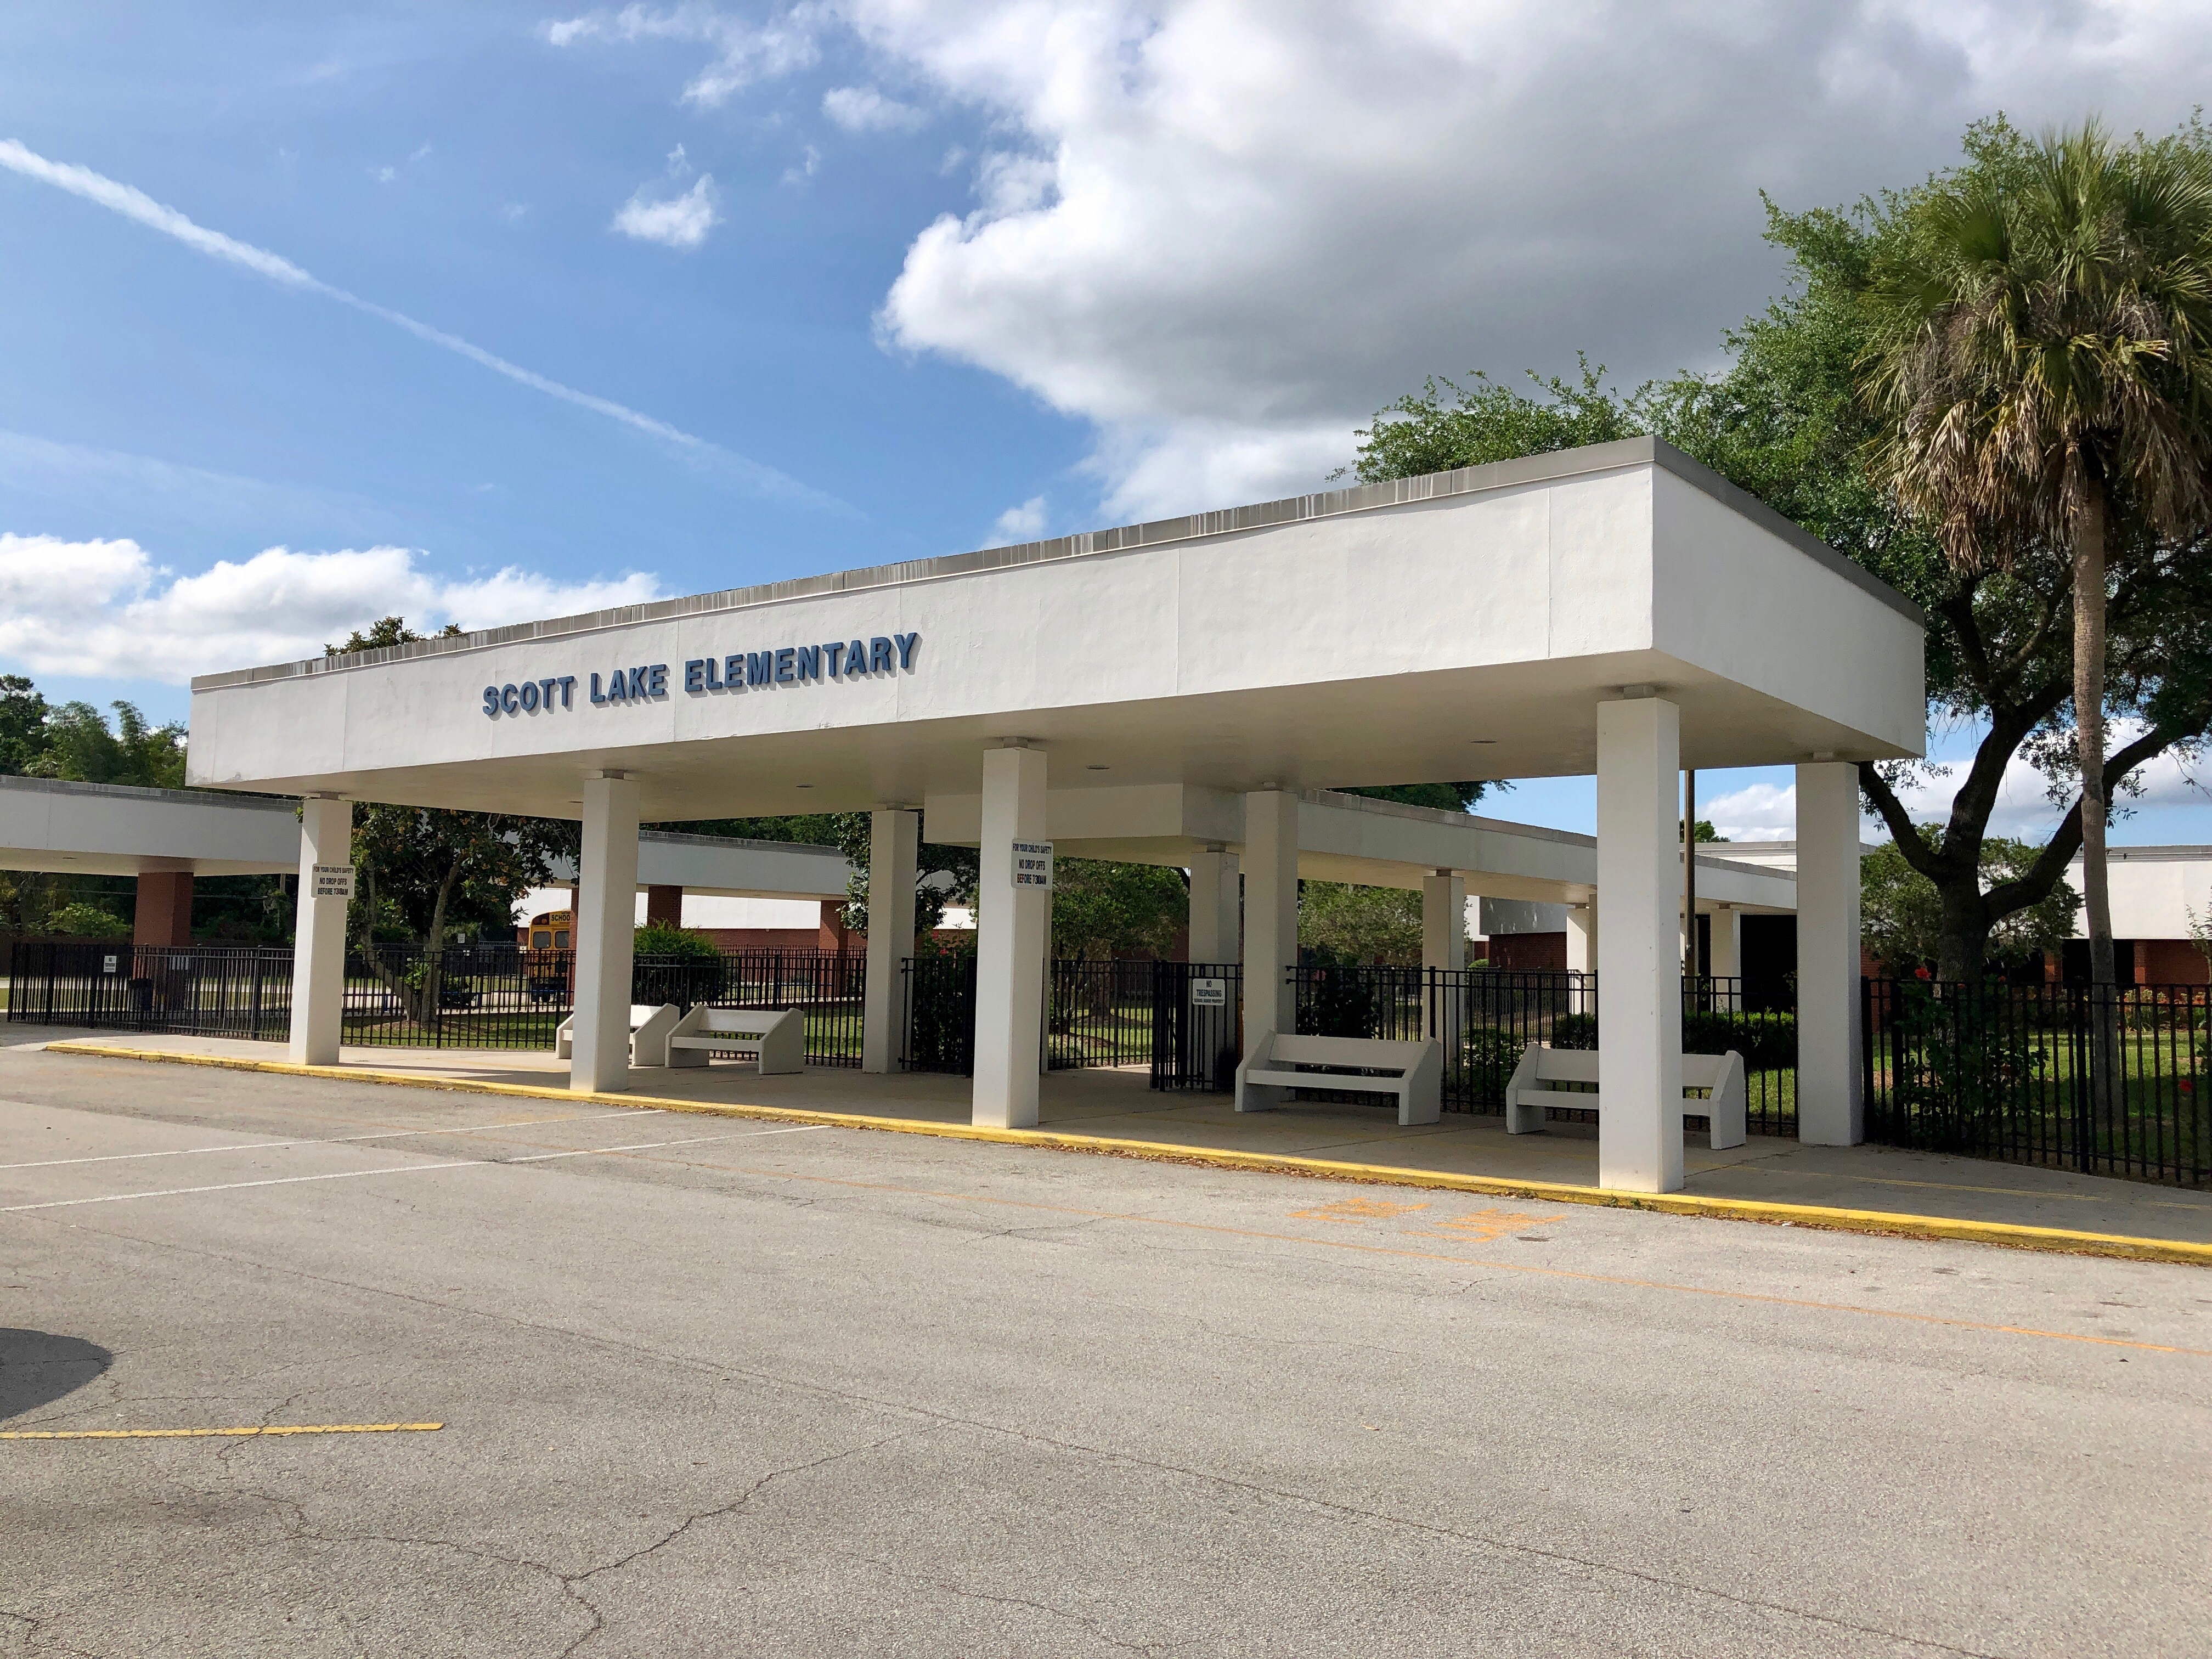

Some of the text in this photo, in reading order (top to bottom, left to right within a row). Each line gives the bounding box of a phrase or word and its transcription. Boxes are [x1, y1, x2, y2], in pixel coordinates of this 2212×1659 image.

[482, 631, 918, 716] SCOTT LAKE ELEMENTARY
[1019, 844, 1028, 852] YOUR
[1041, 845, 1052, 854] SAFETY
[1019, 859, 1046, 871] NO DROP OFFS
[1017, 873, 1031, 884] BEFORE
